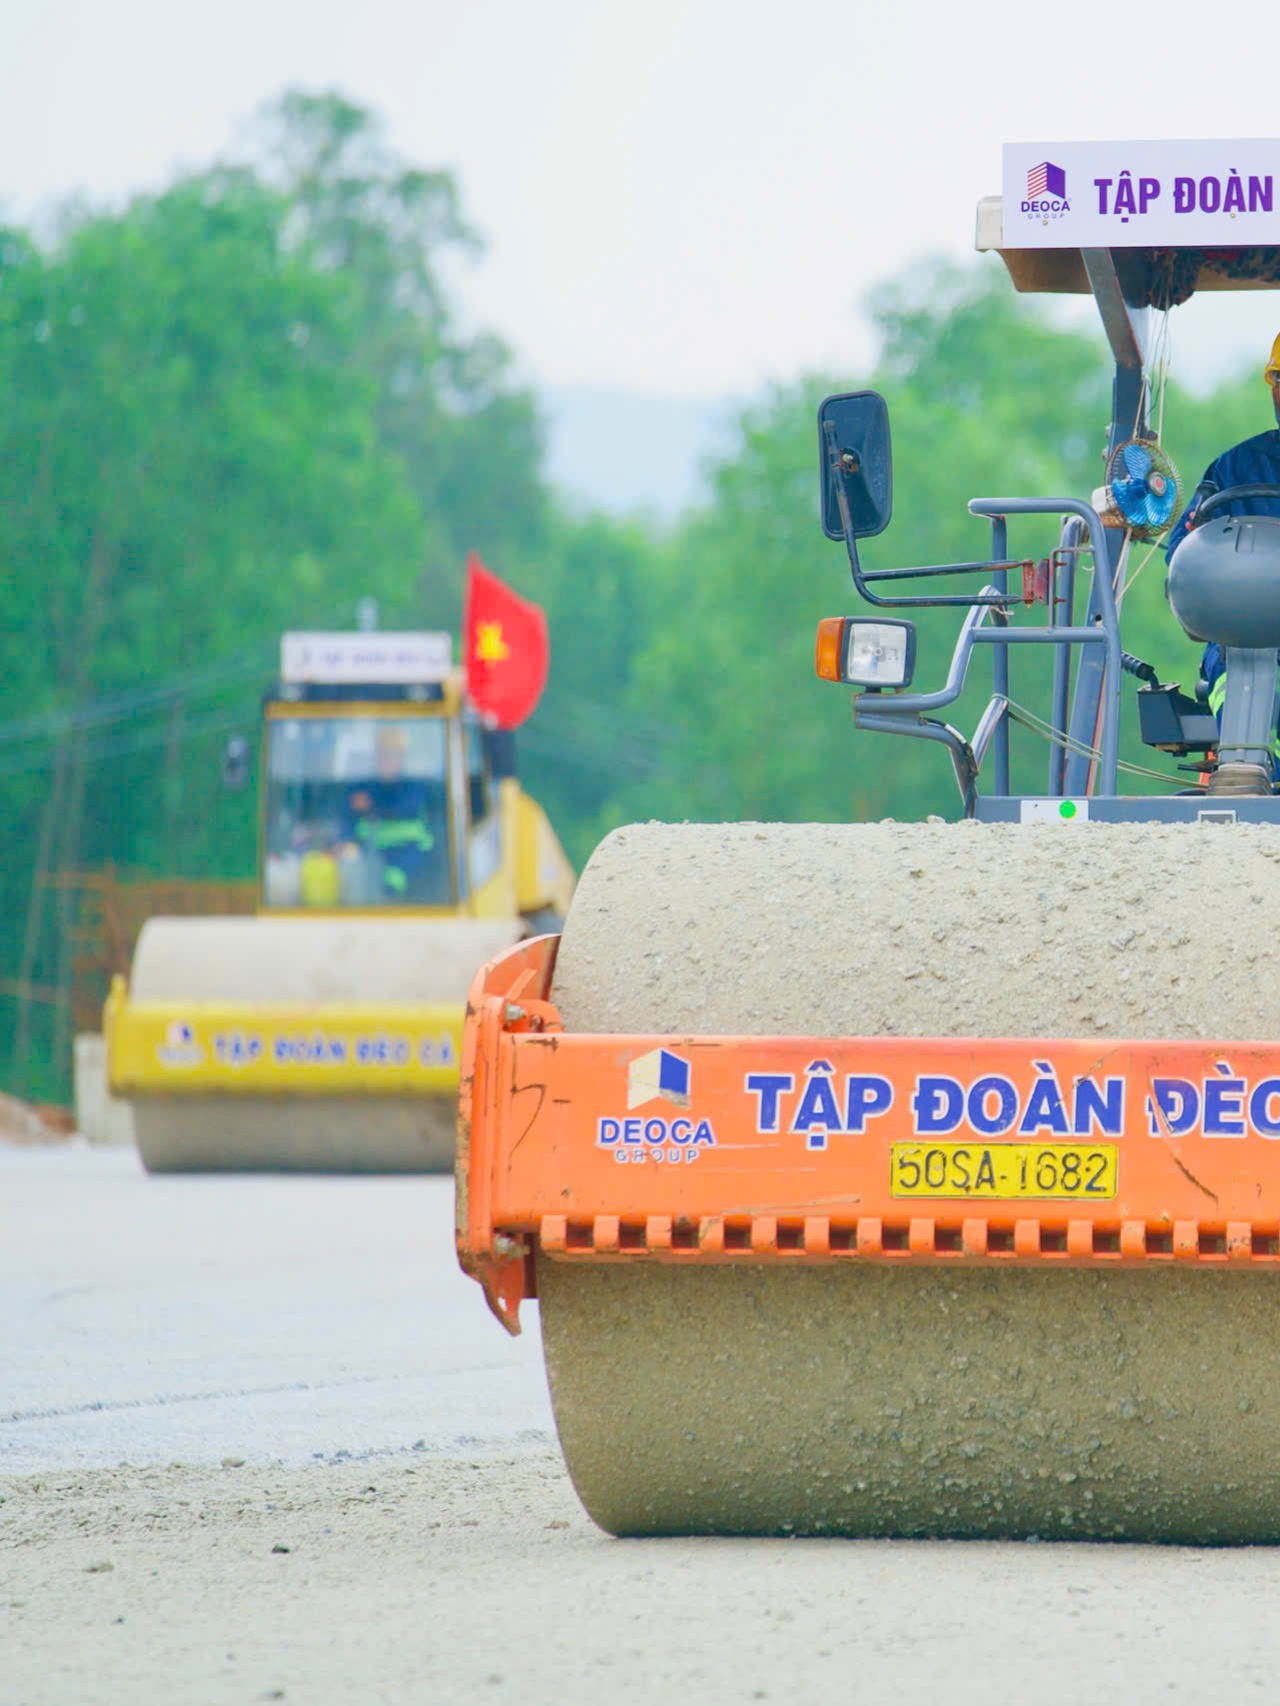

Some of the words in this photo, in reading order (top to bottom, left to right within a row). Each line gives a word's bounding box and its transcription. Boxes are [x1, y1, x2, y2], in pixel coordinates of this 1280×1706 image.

[1020, 200, 1071, 213] DEOCA
[1093, 169, 1161, 223] TẬP
[1173, 167, 1273, 214] ĐOÀN
[1027, 212, 1066, 220] GROUP
[745, 1059, 893, 1149] TẬP
[911, 1060, 1125, 1137] ĐOÀN
[599, 1117, 717, 1146] DEOCA
[614, 1147, 700, 1164] GROUP
[898, 1149, 1109, 1193] 50SA-1682
